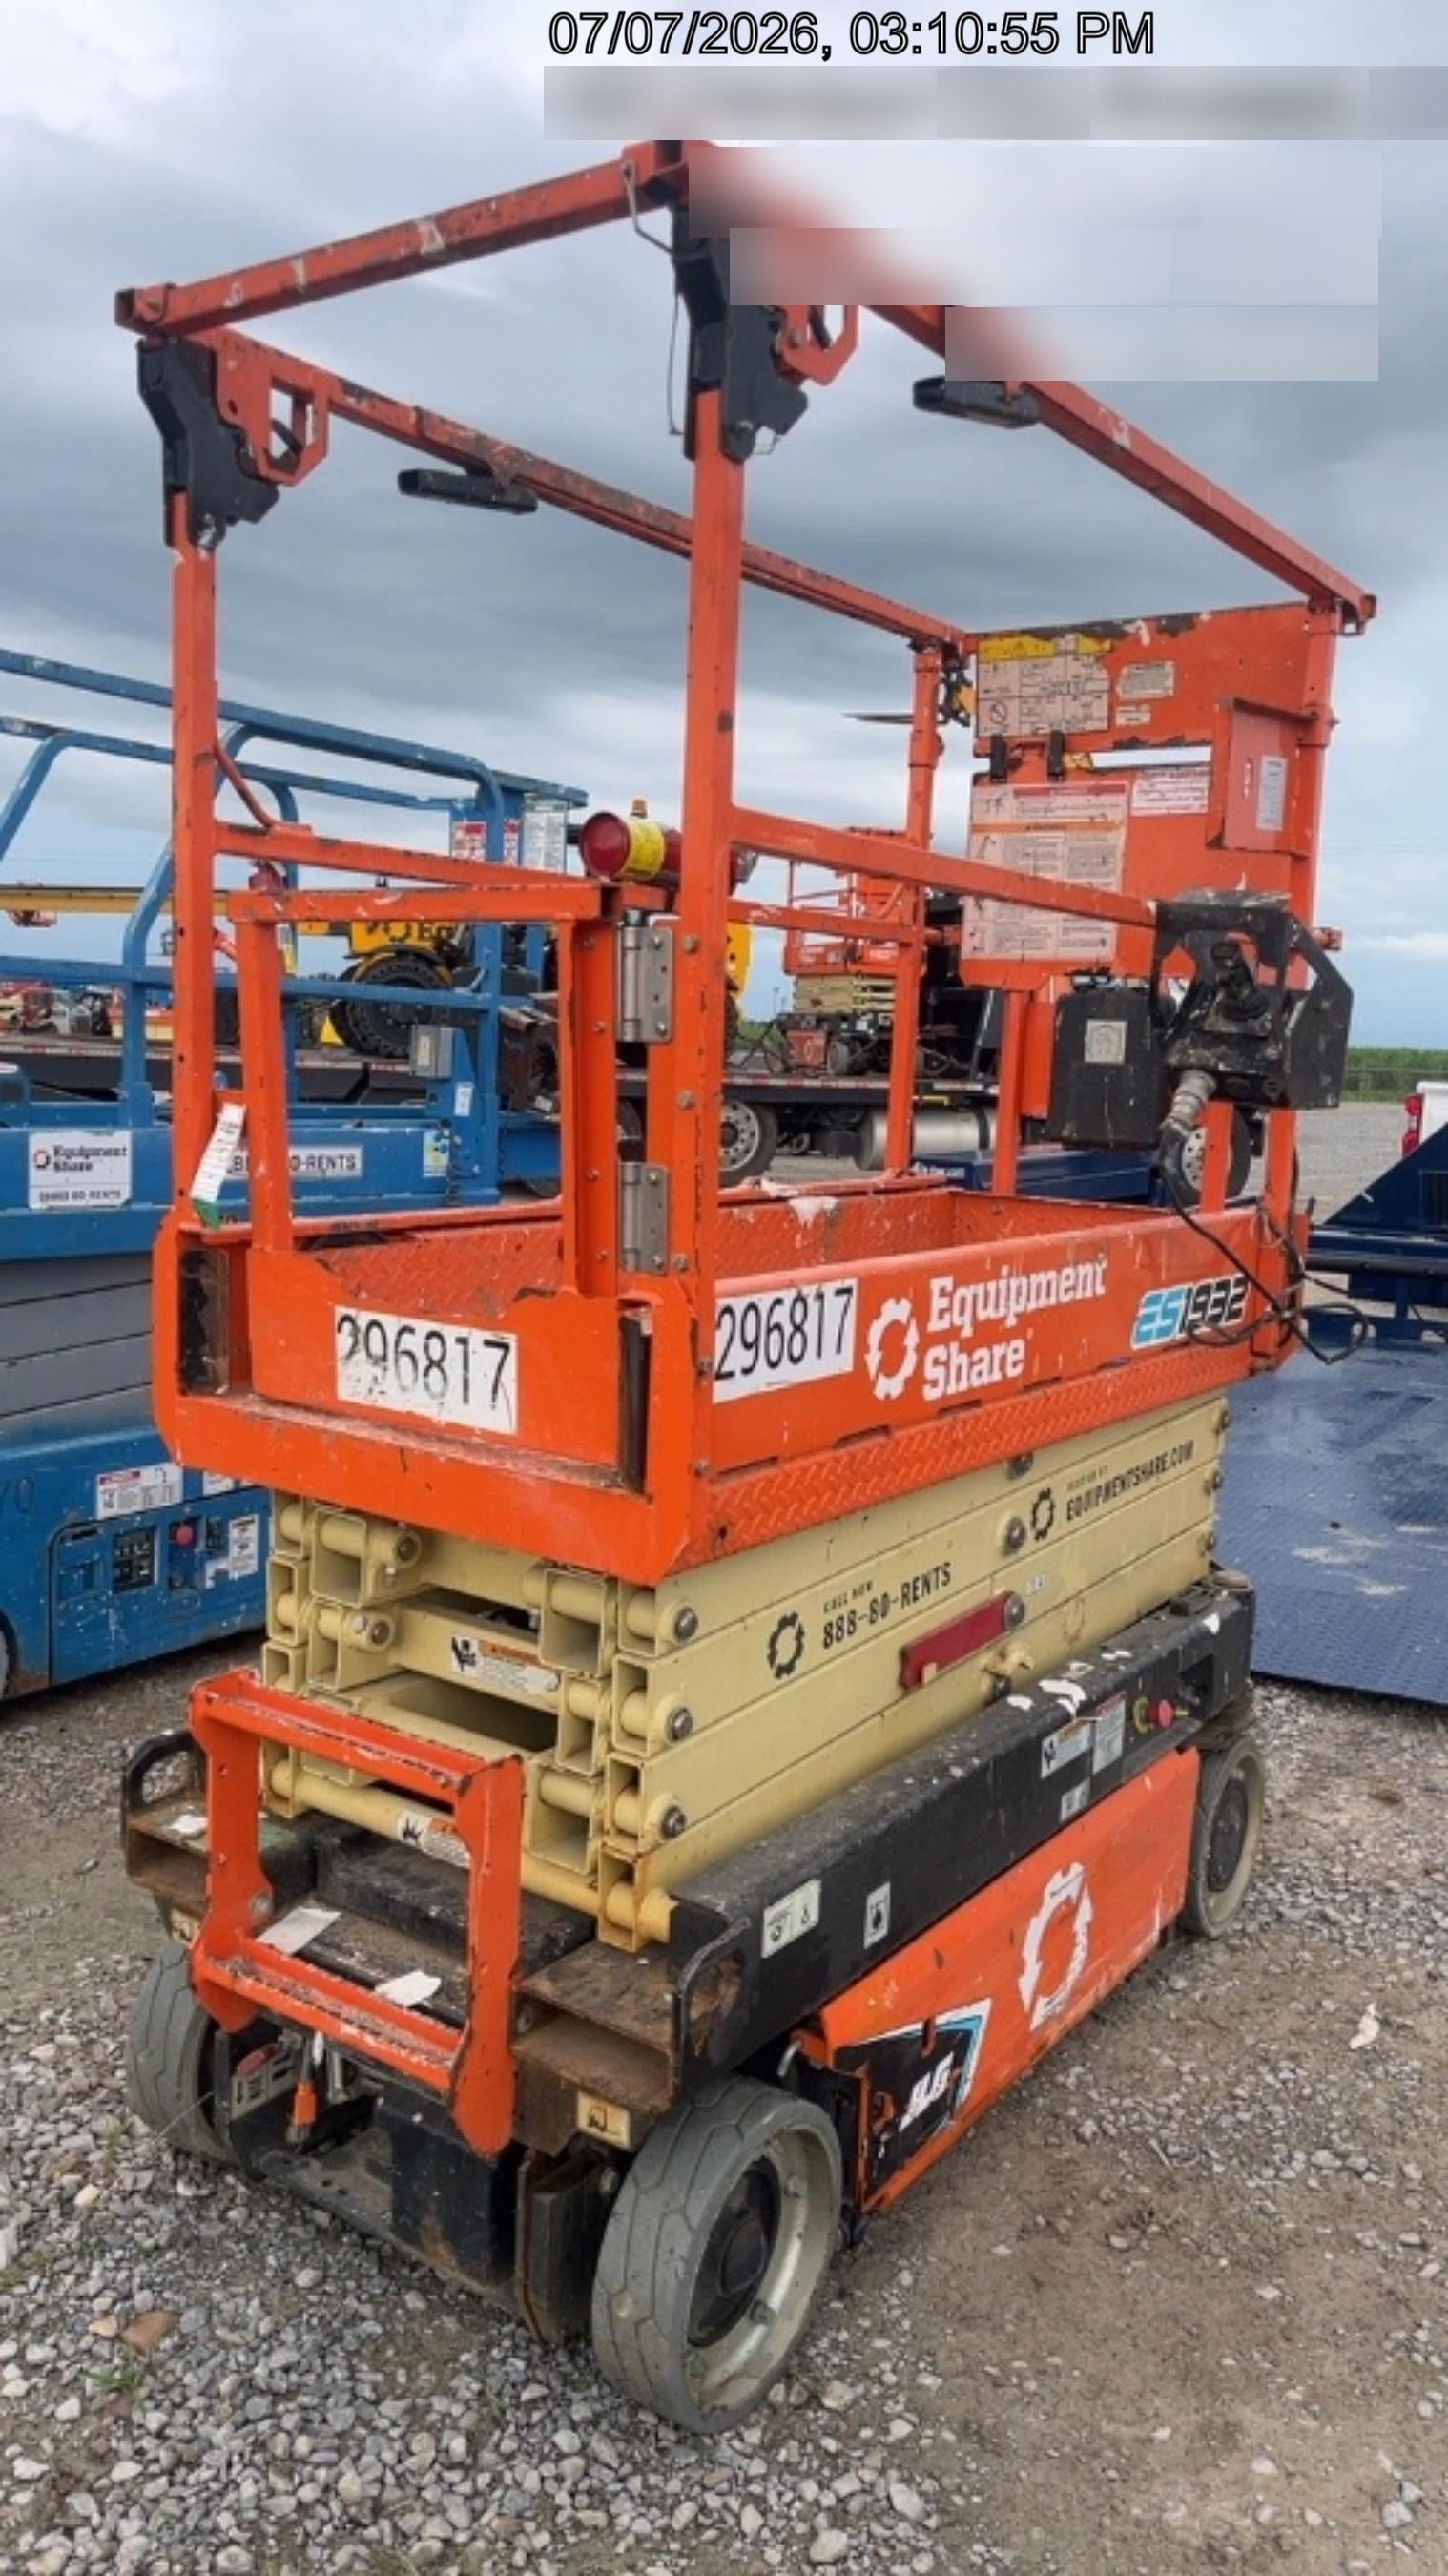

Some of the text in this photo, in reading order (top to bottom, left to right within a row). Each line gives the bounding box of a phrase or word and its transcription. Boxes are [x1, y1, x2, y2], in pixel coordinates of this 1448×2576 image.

[715, 1286, 854, 1381] 296817
[926, 1257, 1107, 1339] Equipment
[1132, 1273, 1250, 1348] ES1932
[337, 1313, 510, 1410] 296817
[922, 1338, 1025, 1401] Share
[823, 1562, 951, 1649] 888-80-RENTS
